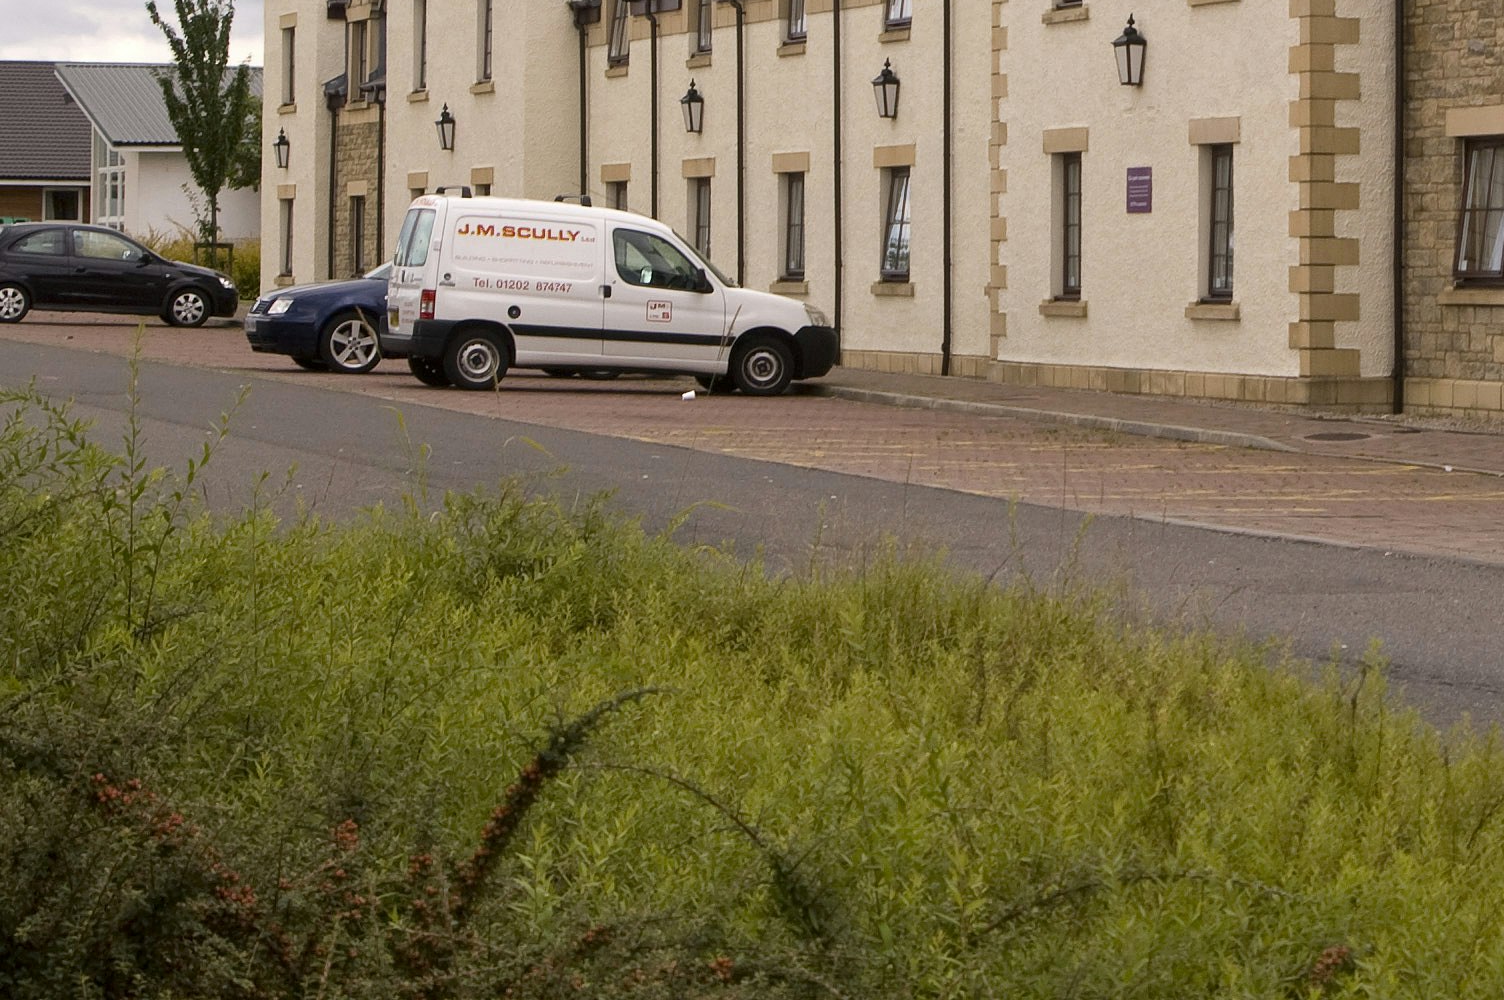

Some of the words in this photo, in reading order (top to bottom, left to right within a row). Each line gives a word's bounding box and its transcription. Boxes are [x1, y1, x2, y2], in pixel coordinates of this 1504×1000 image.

[458, 224, 580, 241] J.M.SCULLY
[473, 278, 493, 289] Tel.
[496, 279, 529, 291] 01202
